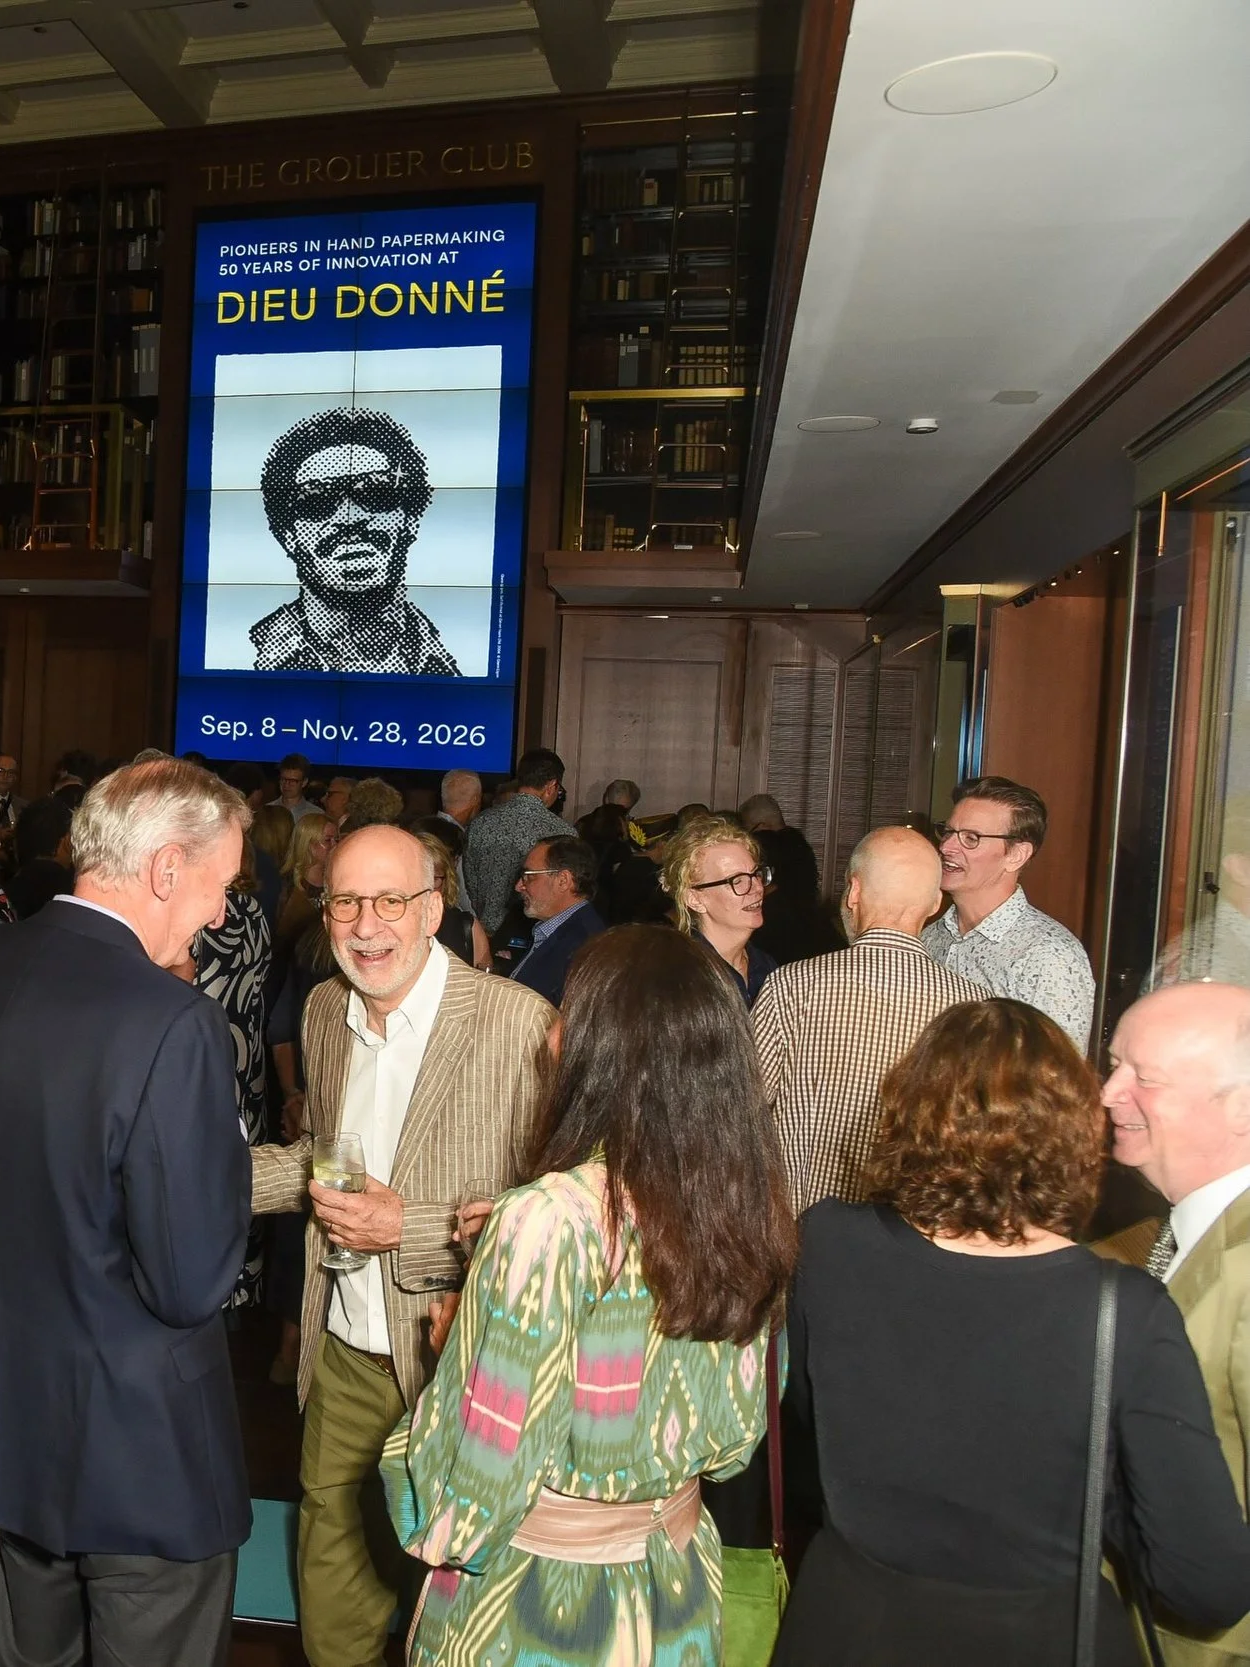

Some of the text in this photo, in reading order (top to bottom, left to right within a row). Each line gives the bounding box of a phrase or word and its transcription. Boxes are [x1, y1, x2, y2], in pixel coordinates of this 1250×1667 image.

[200, 141, 535, 193] THE GROLIER CLUB
[219, 229, 506, 258] PIONEERS IN HAND PAPERMAKING
[218, 251, 460, 276] 50 YEARS OF INNOVATION AT
[216, 269, 506, 324] DIEU DONNÉ
[200, 714, 254, 741] Sep.
[260, 717, 276, 738] 8
[302, 719, 359, 742] Nov.
[368, 721, 408, 747] 28,
[417, 723, 486, 747] 2026
